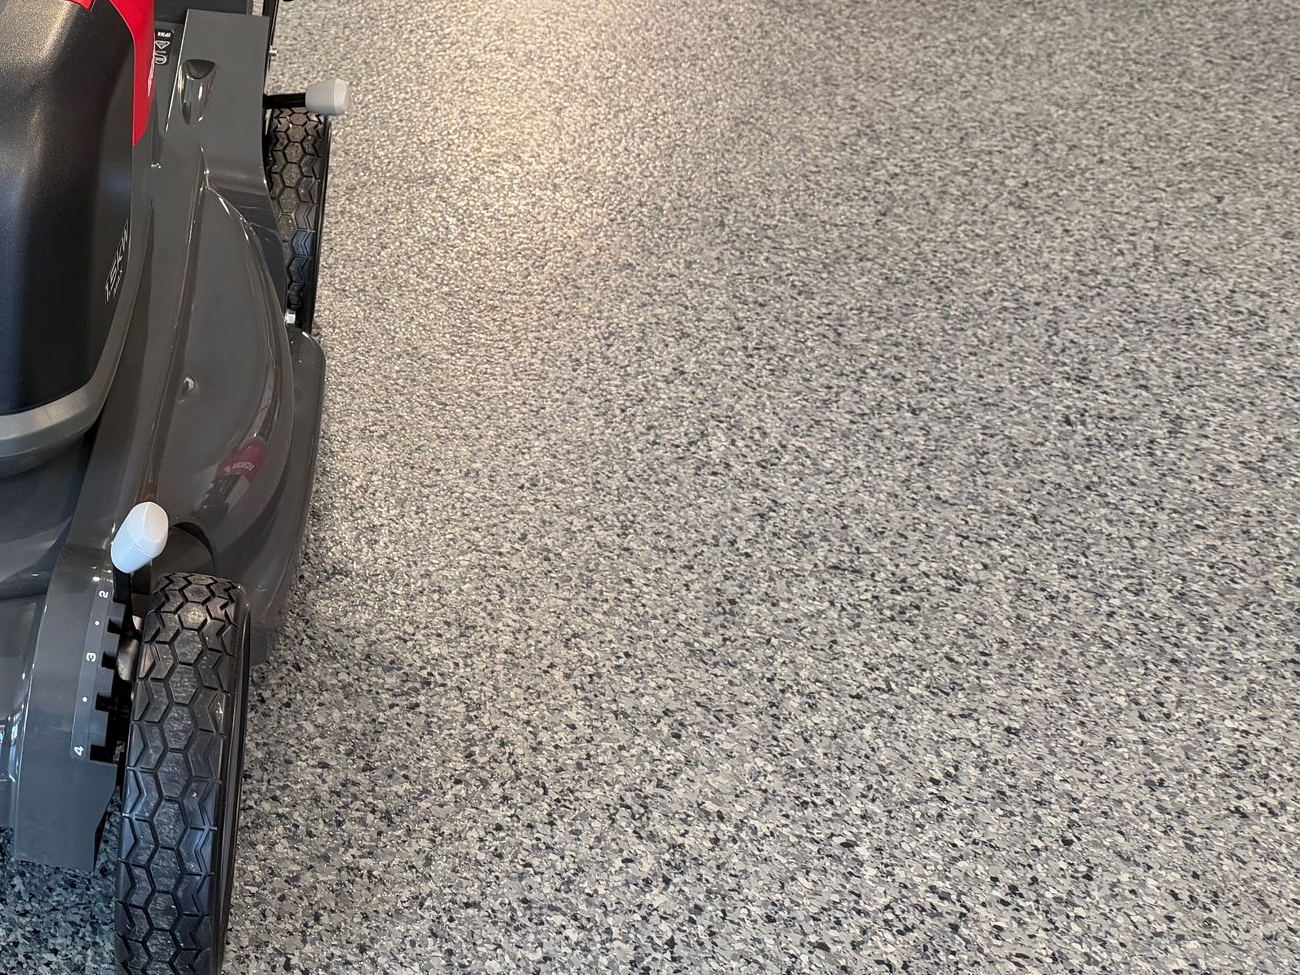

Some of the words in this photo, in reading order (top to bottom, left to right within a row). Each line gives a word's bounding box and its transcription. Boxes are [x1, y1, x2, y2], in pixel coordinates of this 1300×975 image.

[98, 590, 109, 599] 2
[86, 651, 97, 662] 3
[73, 745, 84, 756] 4
